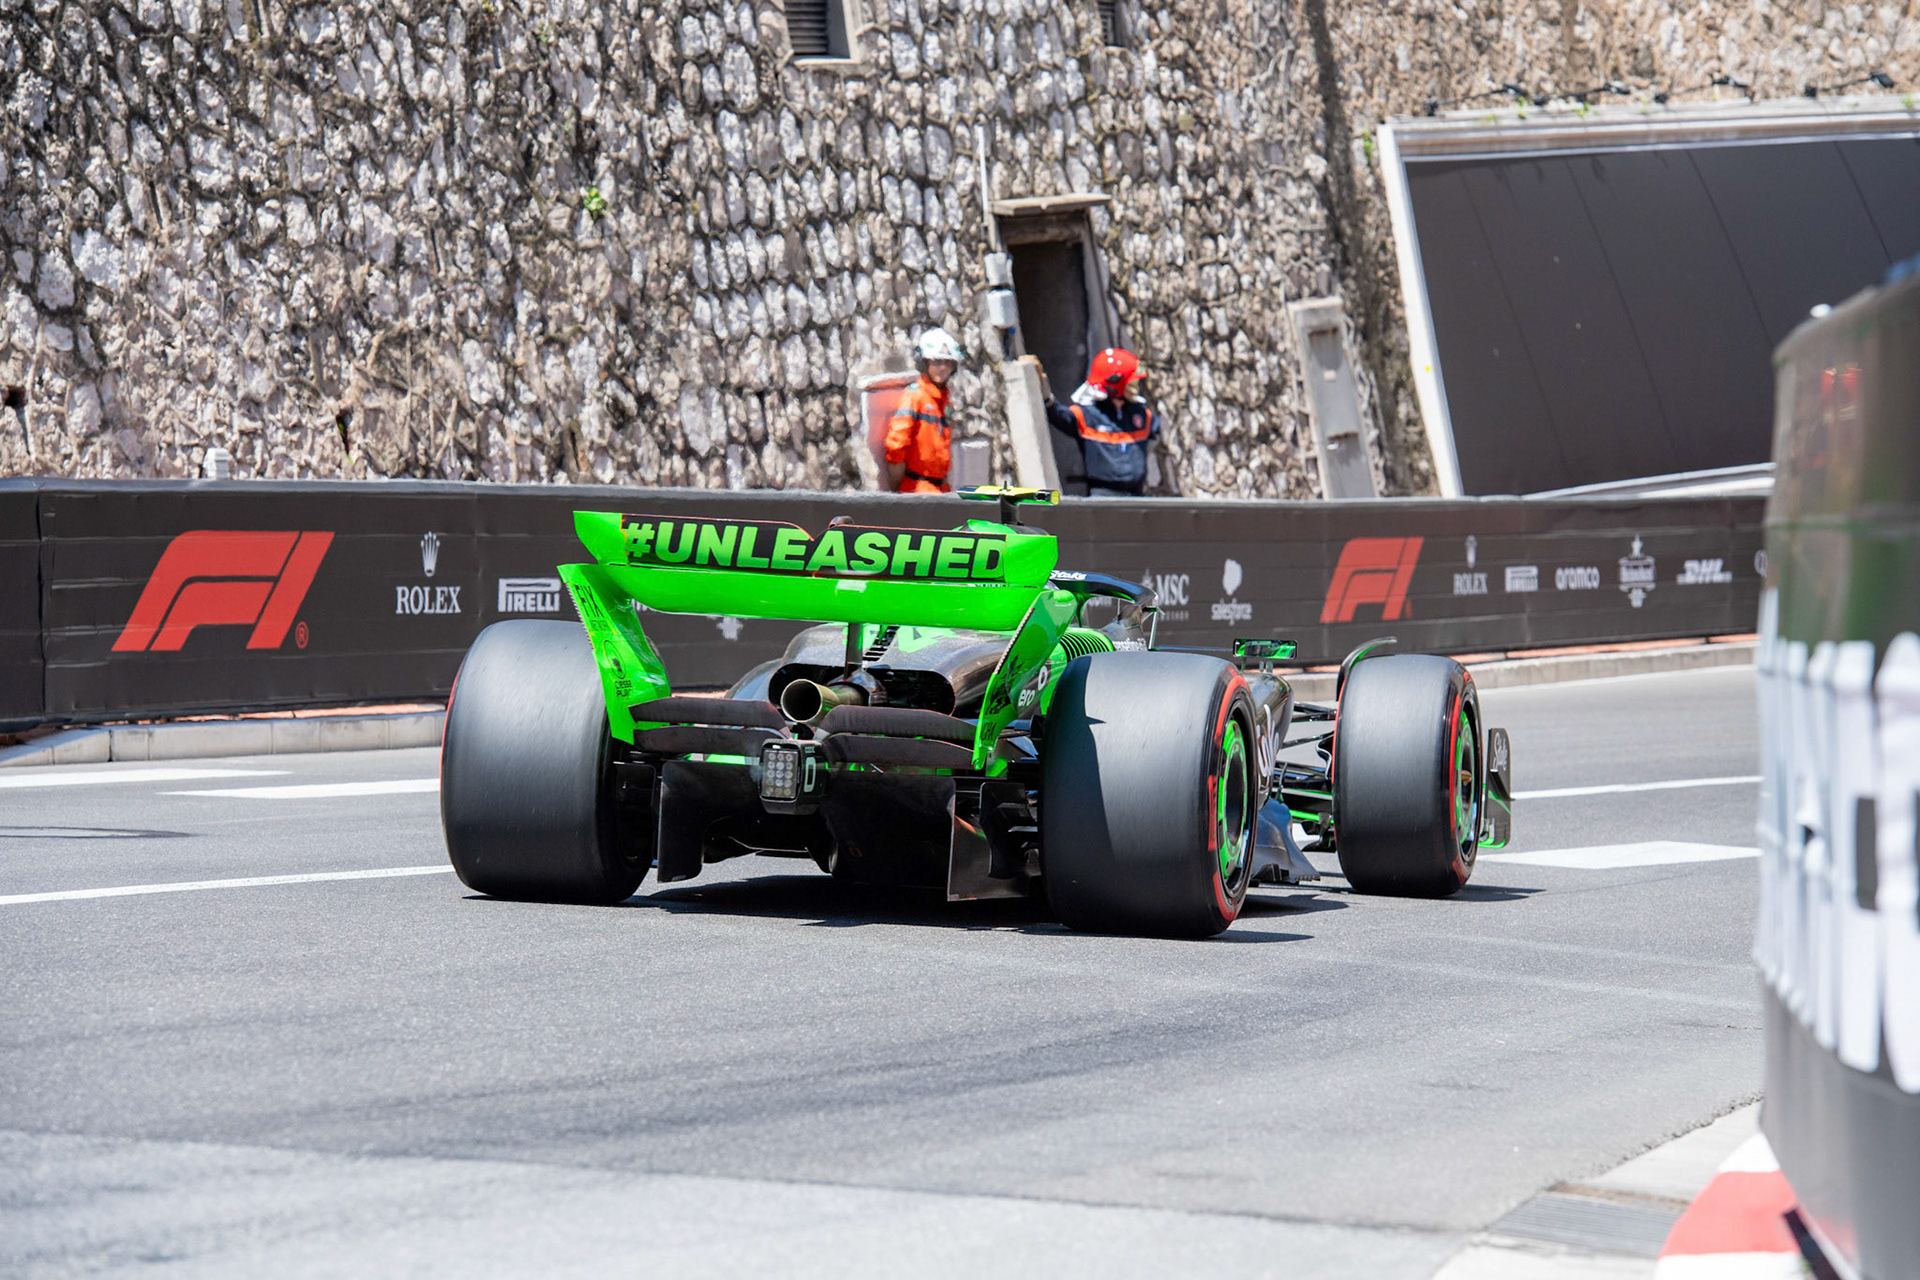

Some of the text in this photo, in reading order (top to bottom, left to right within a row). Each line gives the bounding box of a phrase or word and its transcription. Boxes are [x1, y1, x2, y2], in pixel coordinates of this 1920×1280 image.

[624, 520, 1006, 581] #UNLEASHED
[1049, 570, 1087, 581] Stake
[1319, 537, 1424, 623] F1
[1453, 572, 1488, 596] ROLEX
[1555, 566, 1600, 591] aramco
[1680, 558, 1728, 585] DHL
[111, 530, 335, 652] F1
[395, 586, 461, 614] ROLEX
[498, 577, 561, 613] PIRELLI
[574, 584, 605, 618] FIX
[1155, 574, 1190, 606] MSC
